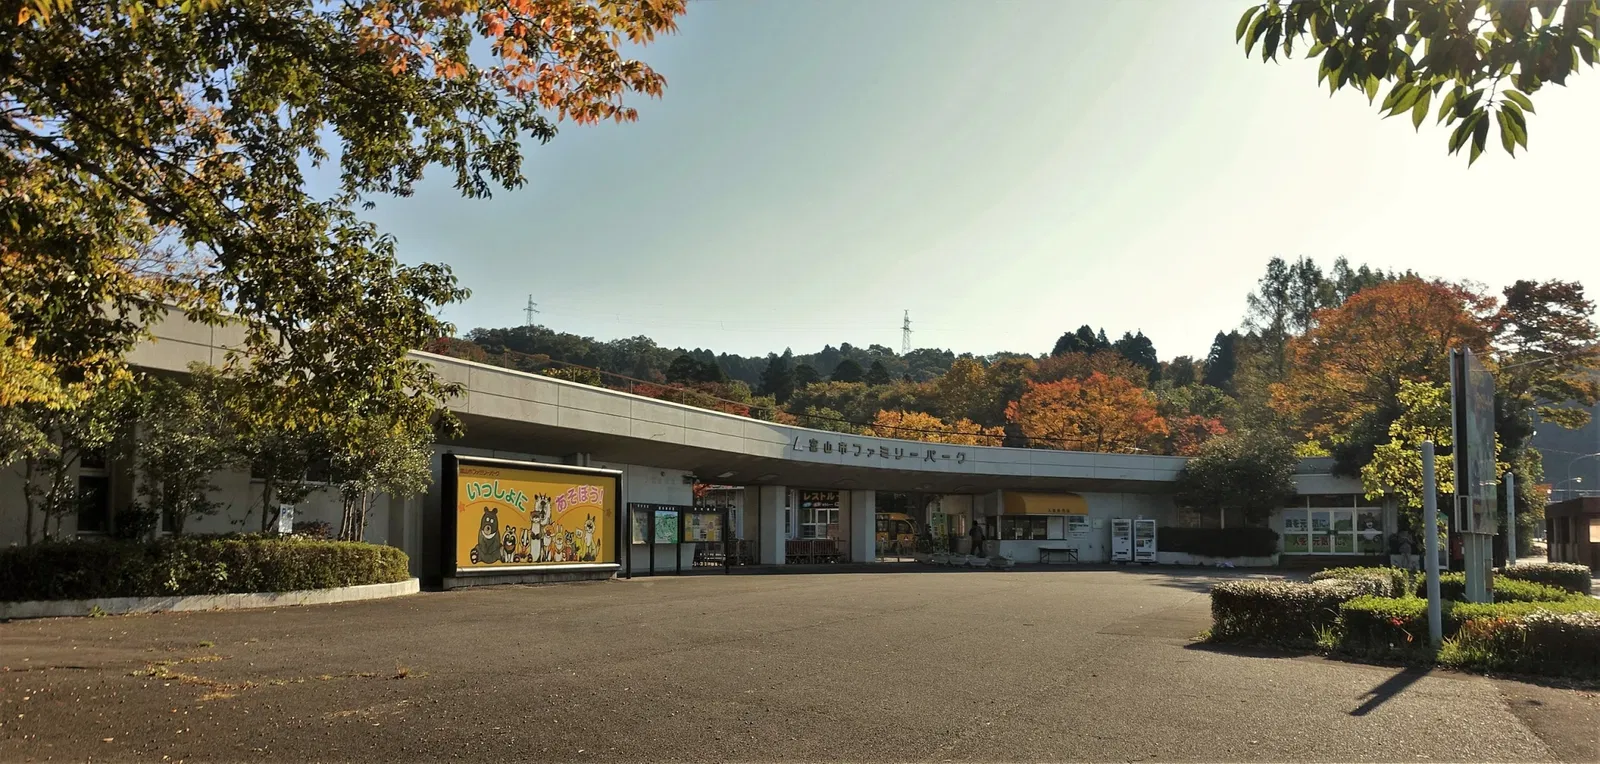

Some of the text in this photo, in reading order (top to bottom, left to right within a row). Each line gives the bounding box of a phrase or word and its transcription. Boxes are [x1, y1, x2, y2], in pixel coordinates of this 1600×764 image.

[808, 438, 966, 464] 富山市ファミリーパーク
[466, 479, 529, 514] いっしょに
